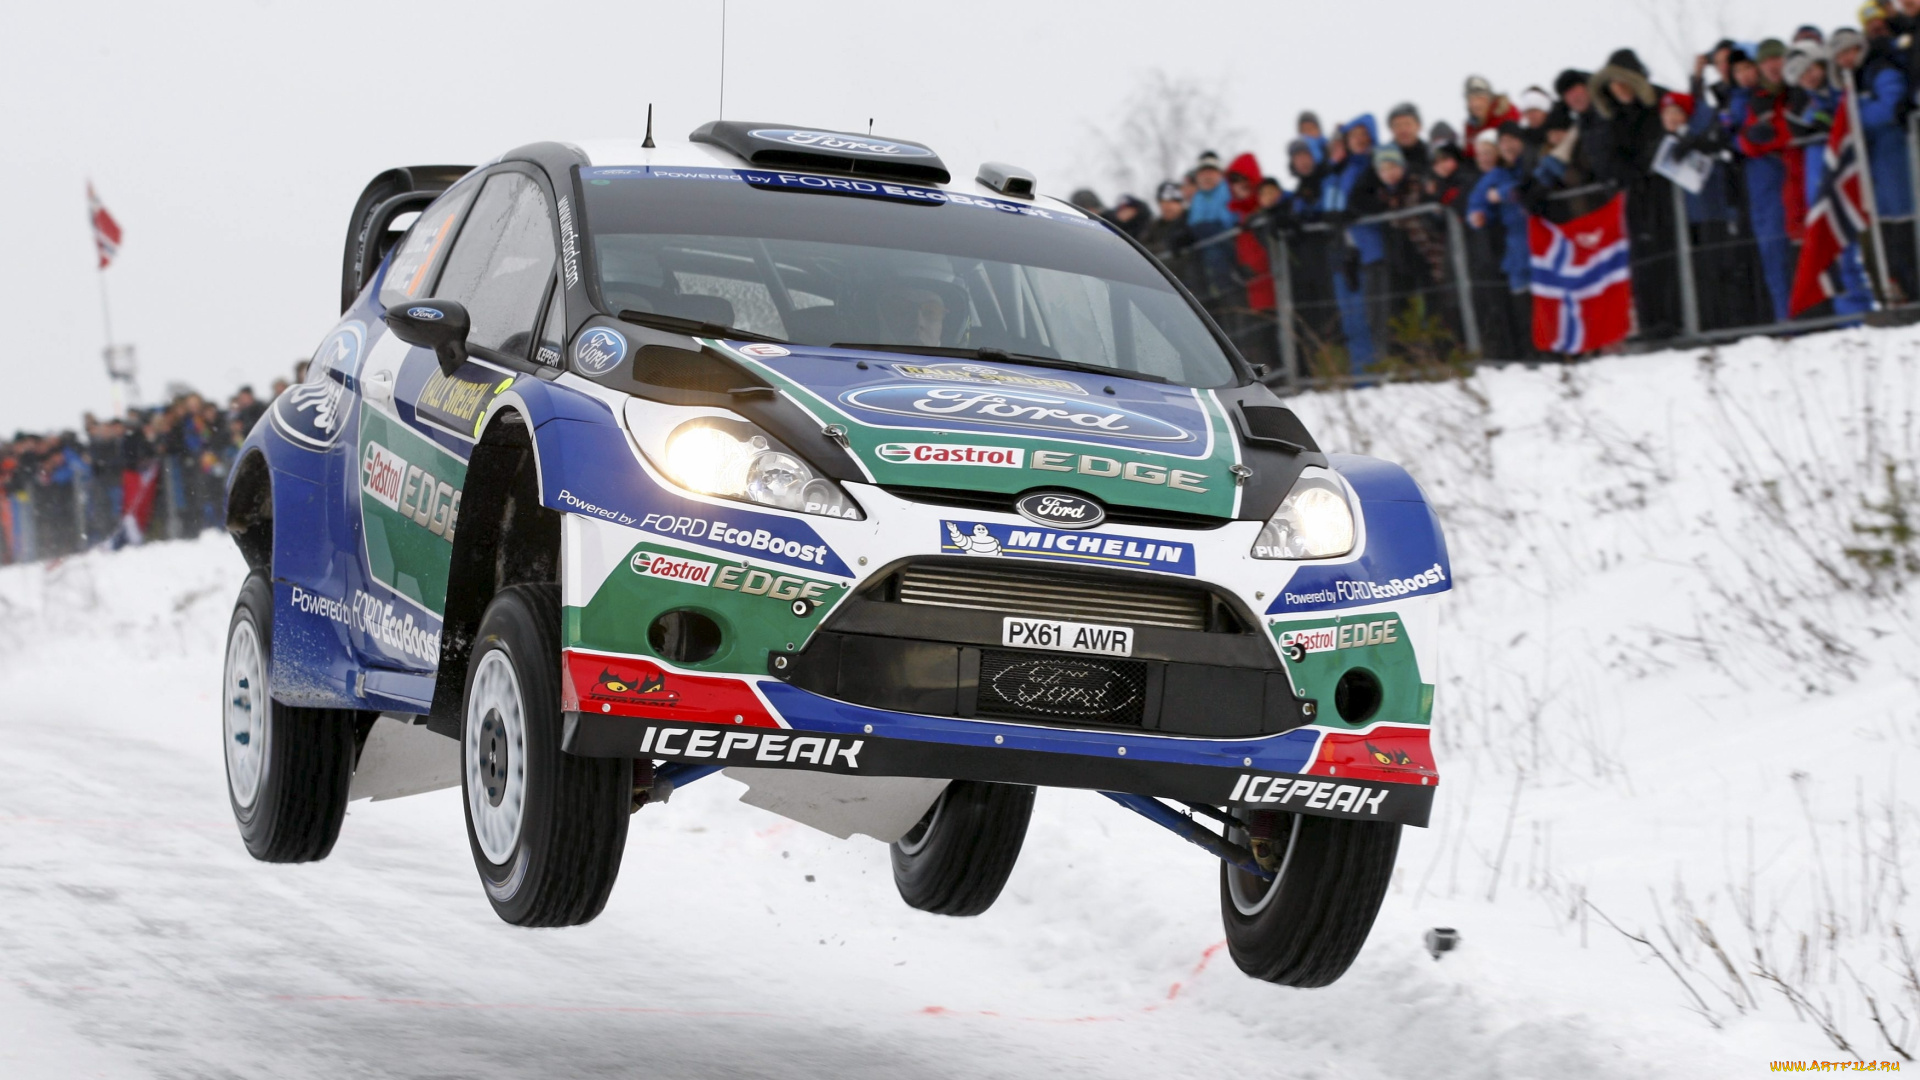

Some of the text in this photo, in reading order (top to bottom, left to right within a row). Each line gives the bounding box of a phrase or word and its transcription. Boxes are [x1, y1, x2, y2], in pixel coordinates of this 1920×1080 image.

[786, 131, 900, 154] Ford
[653, 170, 1053, 220] Powered by FORD EcoBoost
[413, 308, 437, 319] Ford
[579, 332, 616, 370] Ford
[904, 365, 971, 378] RALLY
[978, 372, 1073, 390] SWEDEN
[442, 378, 493, 421] SWEDEN
[913, 387, 1130, 432] Ford
[369, 451, 403, 503] Castrol
[913, 445, 1211, 494] Castrol EDGE
[557, 489, 828, 565] Powered by FORD EcoBoost
[804, 501, 858, 520] PIAA
[1037, 496, 1086, 520] Ford
[1007, 530, 1183, 563] MICHELIN
[1255, 545, 1295, 558] PIAA
[650, 556, 834, 607] Castrol EDGE
[1285, 562, 1446, 605] Powered by FORD EcoBoost
[291, 586, 344, 622] Powered
[352, 589, 383, 639] FORD
[382, 604, 441, 665] EcoBoost
[1008, 621, 1128, 653] PX61 AWR
[1295, 619, 1399, 650] Castrol EDGE
[639, 726, 865, 768] ICEPEAK
[1228, 774, 1390, 815] ICEPEAK
